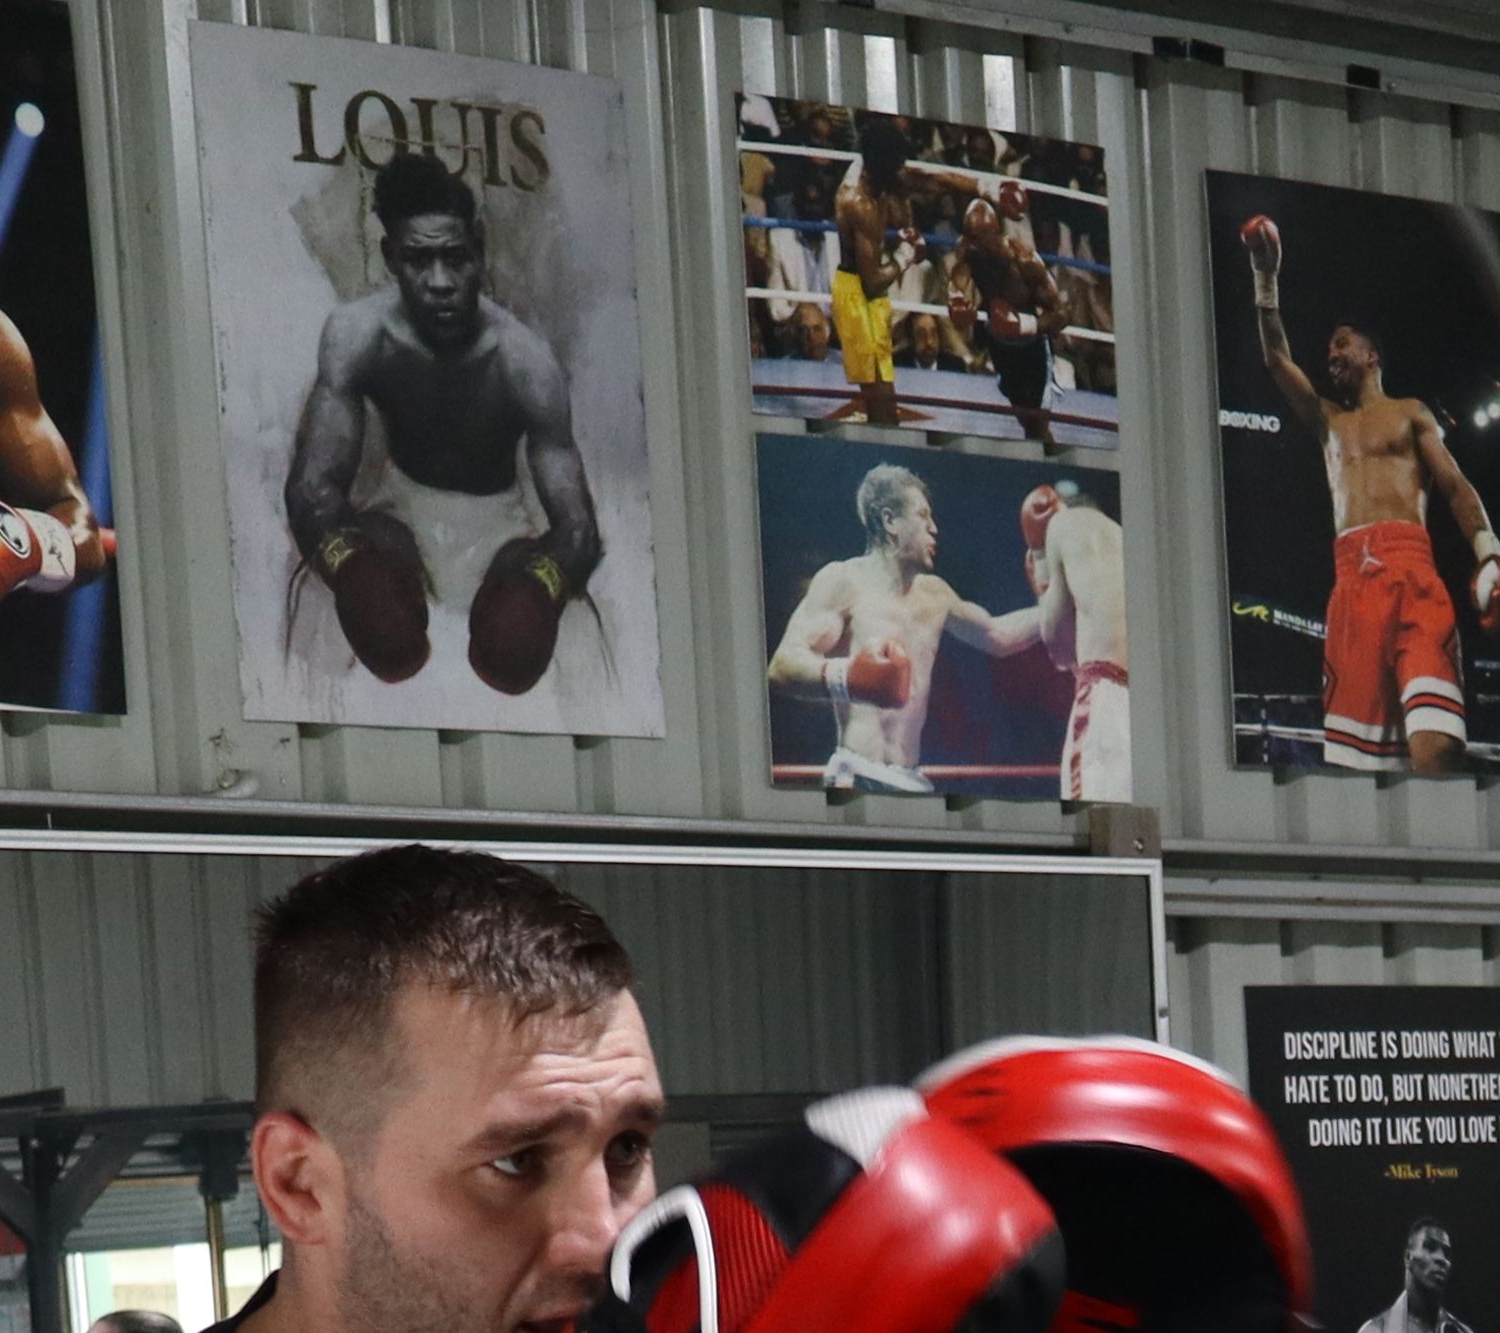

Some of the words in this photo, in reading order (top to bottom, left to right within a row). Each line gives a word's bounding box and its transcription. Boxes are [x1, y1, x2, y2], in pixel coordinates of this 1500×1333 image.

[288, 81, 551, 193] LOUIS
[1284, 1031, 1378, 1060] DISCIPLINE
[1381, 1031, 1398, 1059] IS
[1401, 1031, 1449, 1059] DOING
[1452, 1031, 1496, 1059] WHAT
[1284, 1074, 1331, 1104] HATE
[1333, 1074, 1357, 1103] TO
[1360, 1074, 1389, 1106] DO,
[1392, 1073, 1424, 1102] BUT
[1308, 1118, 1362, 1147] DOING
[1366, 1118, 1382, 1145] IT
[1386, 1117, 1423, 1144] LIKE
[1425, 1116, 1457, 1144] YOU
[1459, 1116, 1497, 1143] LOVE
[1425, 1163, 1459, 1183] Tyson
